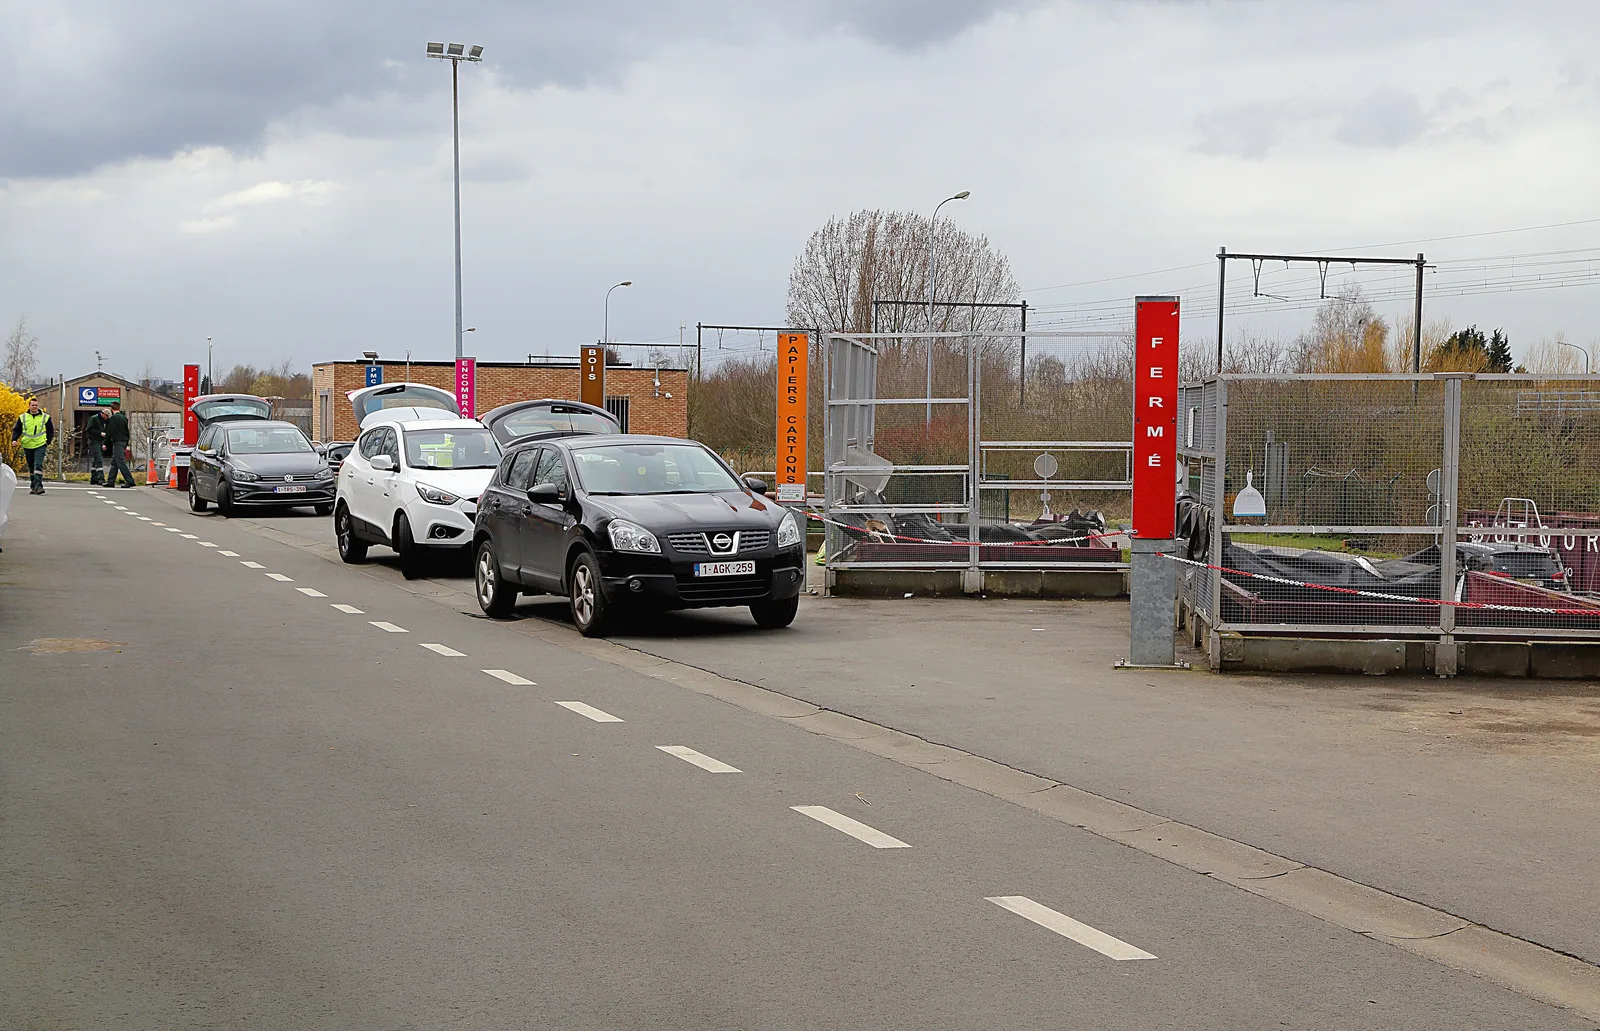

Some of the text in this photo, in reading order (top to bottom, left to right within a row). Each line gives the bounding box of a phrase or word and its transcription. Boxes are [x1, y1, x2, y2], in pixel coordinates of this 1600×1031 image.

[587, 348, 597, 380] BOIS
[787, 335, 798, 404] PAPIERS
[1146, 337, 1164, 467] FERMÉ
[786, 415, 797, 484] CARTONS
[702, 562, 754, 575] 1-AGK-259
